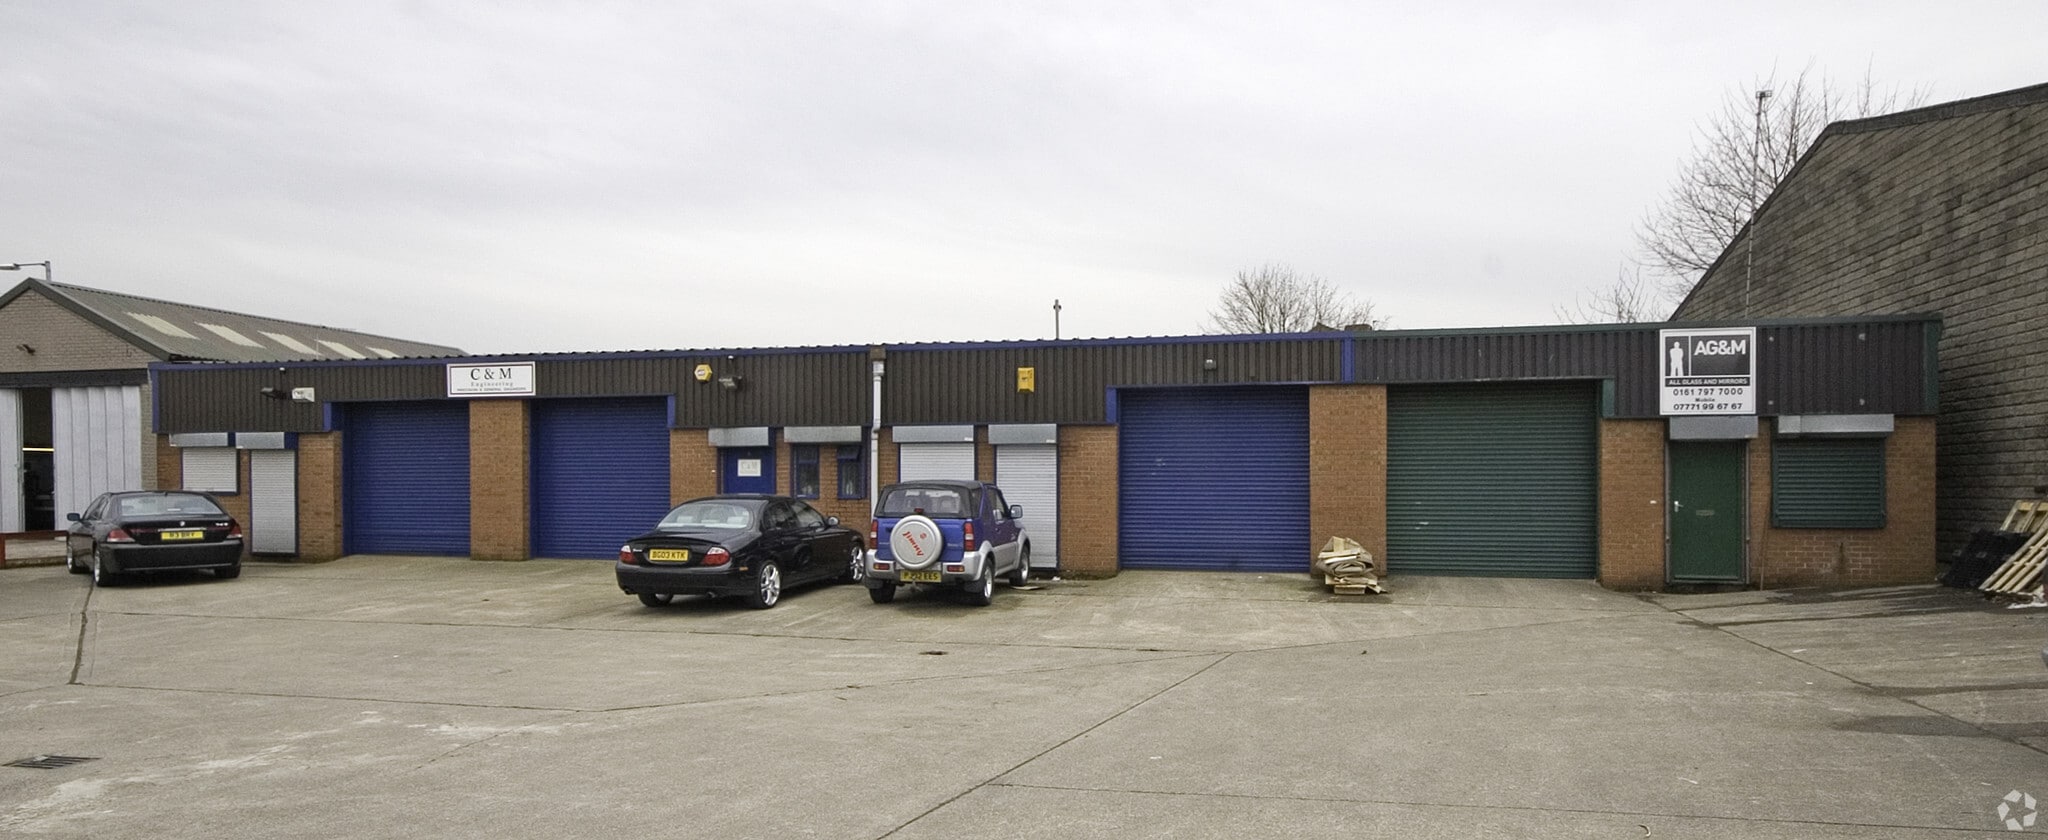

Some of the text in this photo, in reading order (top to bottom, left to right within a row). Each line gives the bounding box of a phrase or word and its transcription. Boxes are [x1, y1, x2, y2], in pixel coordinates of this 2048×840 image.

[1694, 340, 1746, 355] AG&M
[470, 367, 512, 380] C & M
[1698, 388, 1714, 396] 797
